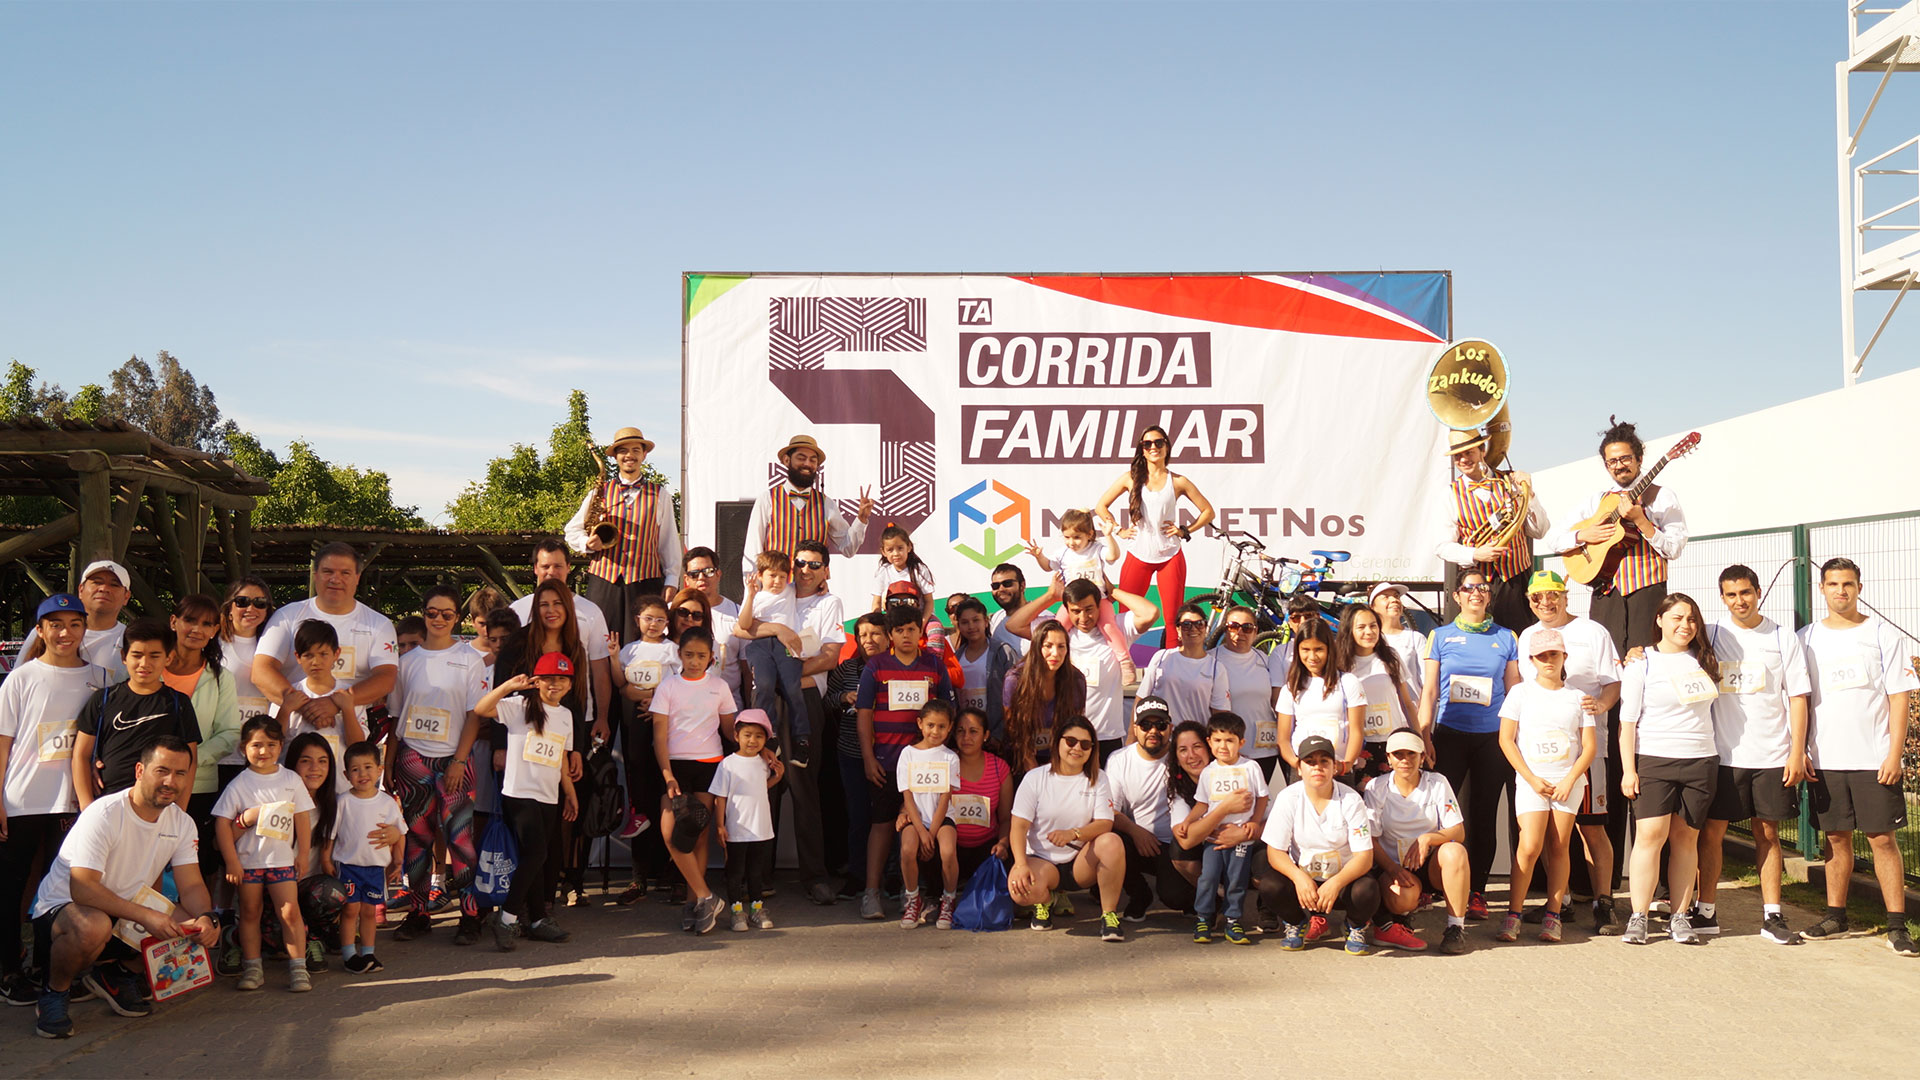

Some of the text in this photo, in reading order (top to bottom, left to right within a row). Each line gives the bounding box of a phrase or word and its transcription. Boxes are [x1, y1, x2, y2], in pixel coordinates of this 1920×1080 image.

[959, 300, 992, 322] TA
[966, 336, 1198, 386] CORRIDA
[1455, 346, 1487, 362] Los
[968, 409, 1258, 458] FAMILIAR
[1351, 554, 1411, 569] Gerencia
[633, 671, 652, 682] 176
[1459, 687, 1480, 699] 154
[1684, 681, 1706, 695] 291
[897, 691, 920, 703] 268
[415, 718, 440, 733] 042
[53, 734, 77, 749] 017
[1260, 731, 1276, 742] 206
[535, 742, 555, 757] 216
[1537, 742, 1559, 755] 155
[916, 773, 940, 785] 263
[1215, 780, 1239, 792] 250
[960, 806, 982, 818] 262
[270, 814, 293, 831] 099
